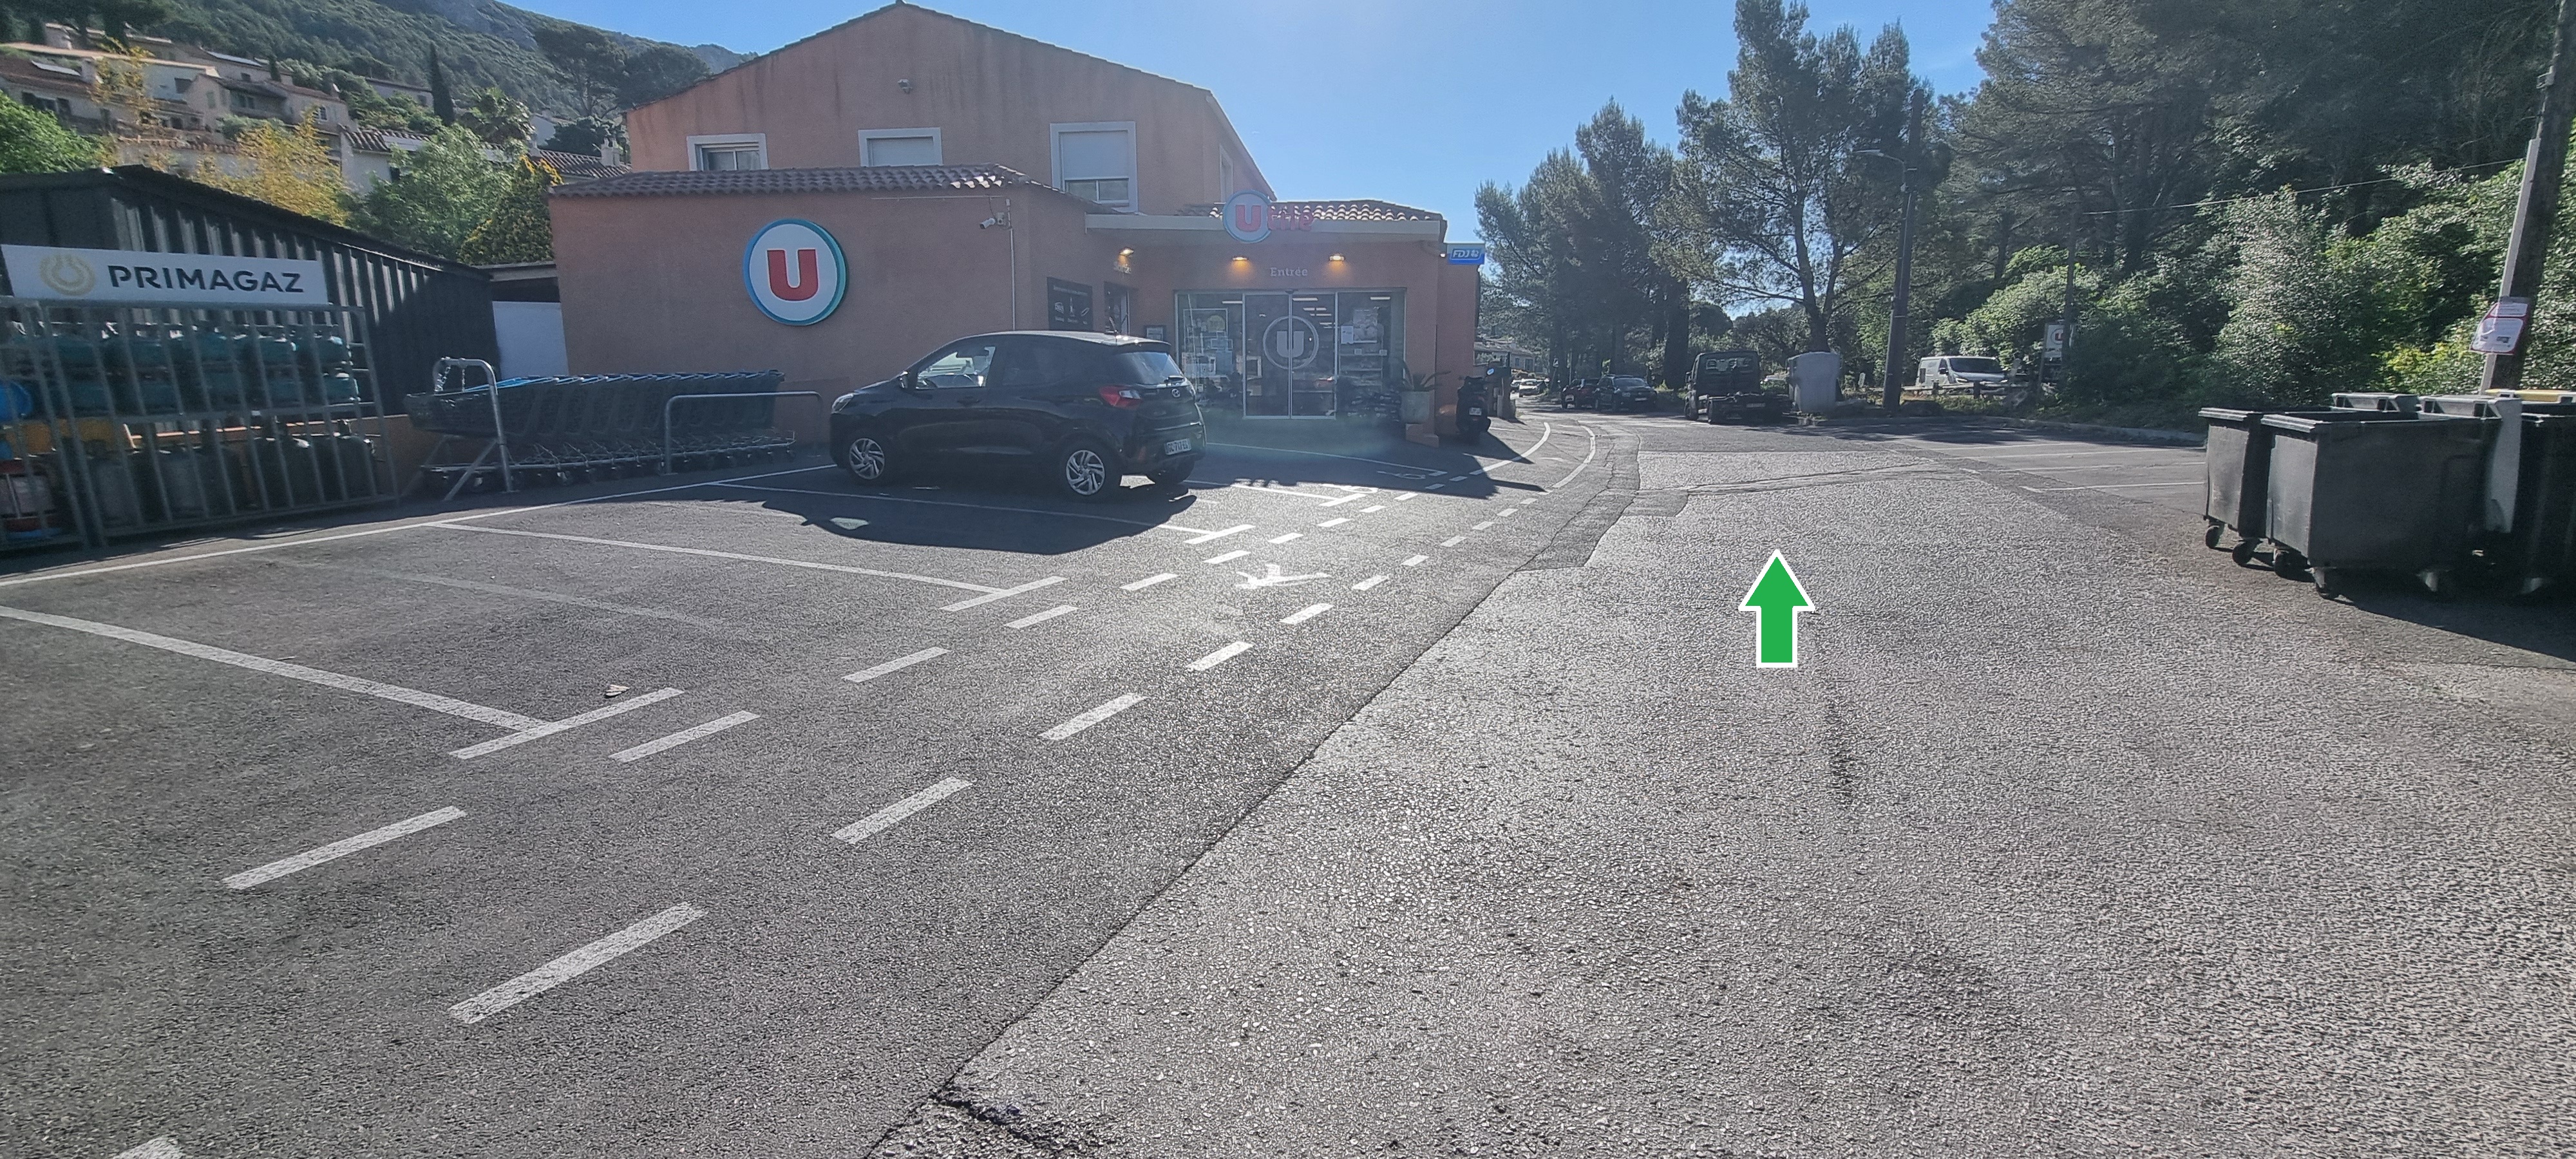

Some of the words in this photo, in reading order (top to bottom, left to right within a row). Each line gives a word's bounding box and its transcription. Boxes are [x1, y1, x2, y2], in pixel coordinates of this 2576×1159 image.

[1453, 249, 1470, 258] FDJ
[108, 265, 304, 293] PRIMAGAZ
[767, 249, 819, 301] U
[1270, 267, 1308, 276] Entrée
[1276, 330, 1304, 358] U
